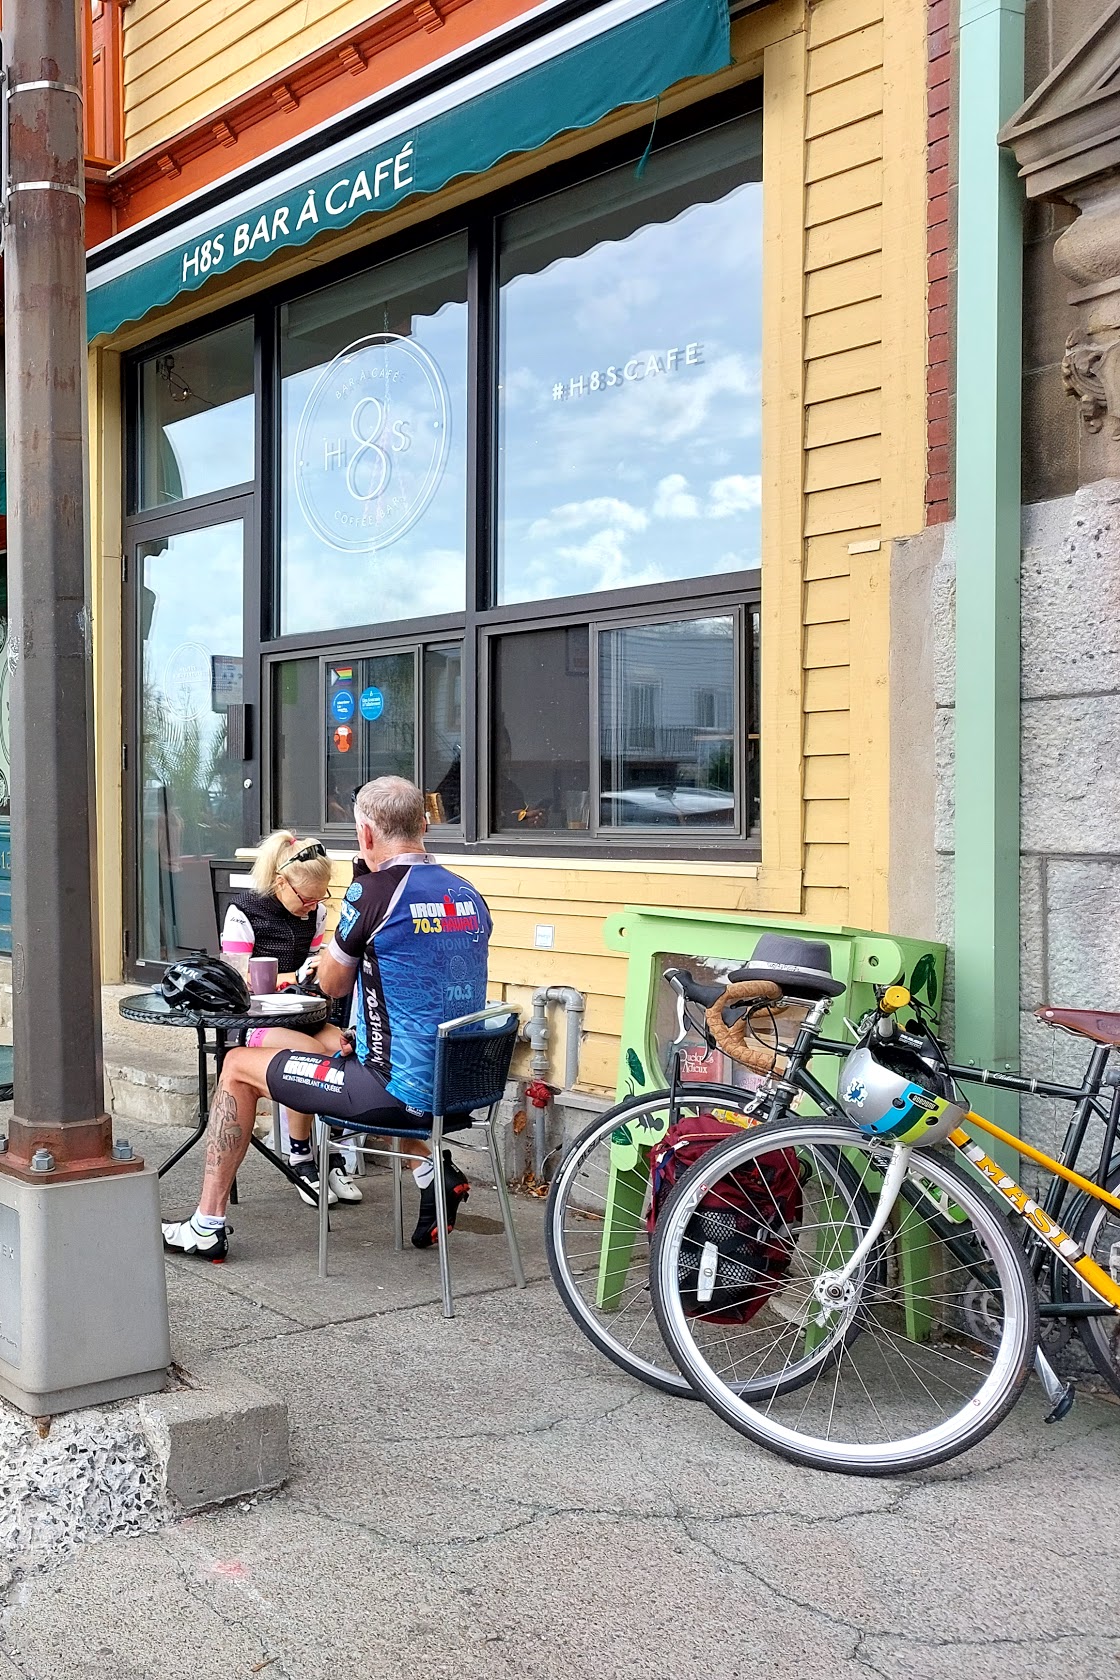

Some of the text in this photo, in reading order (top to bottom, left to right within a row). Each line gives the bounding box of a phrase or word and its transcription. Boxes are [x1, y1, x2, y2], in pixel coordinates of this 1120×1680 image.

[182, 141, 413, 282] H8S BAR À CAFÉ
[552, 343, 697, 401] #H8SCAFE
[336, 379, 355, 399] BAR
[334, 497, 400, 527] COFFEE BAR
[446, 984, 472, 1000] 70.3
[289, 1055, 322, 1064] SUBARU
[975, 1154, 1069, 1247] MASI
